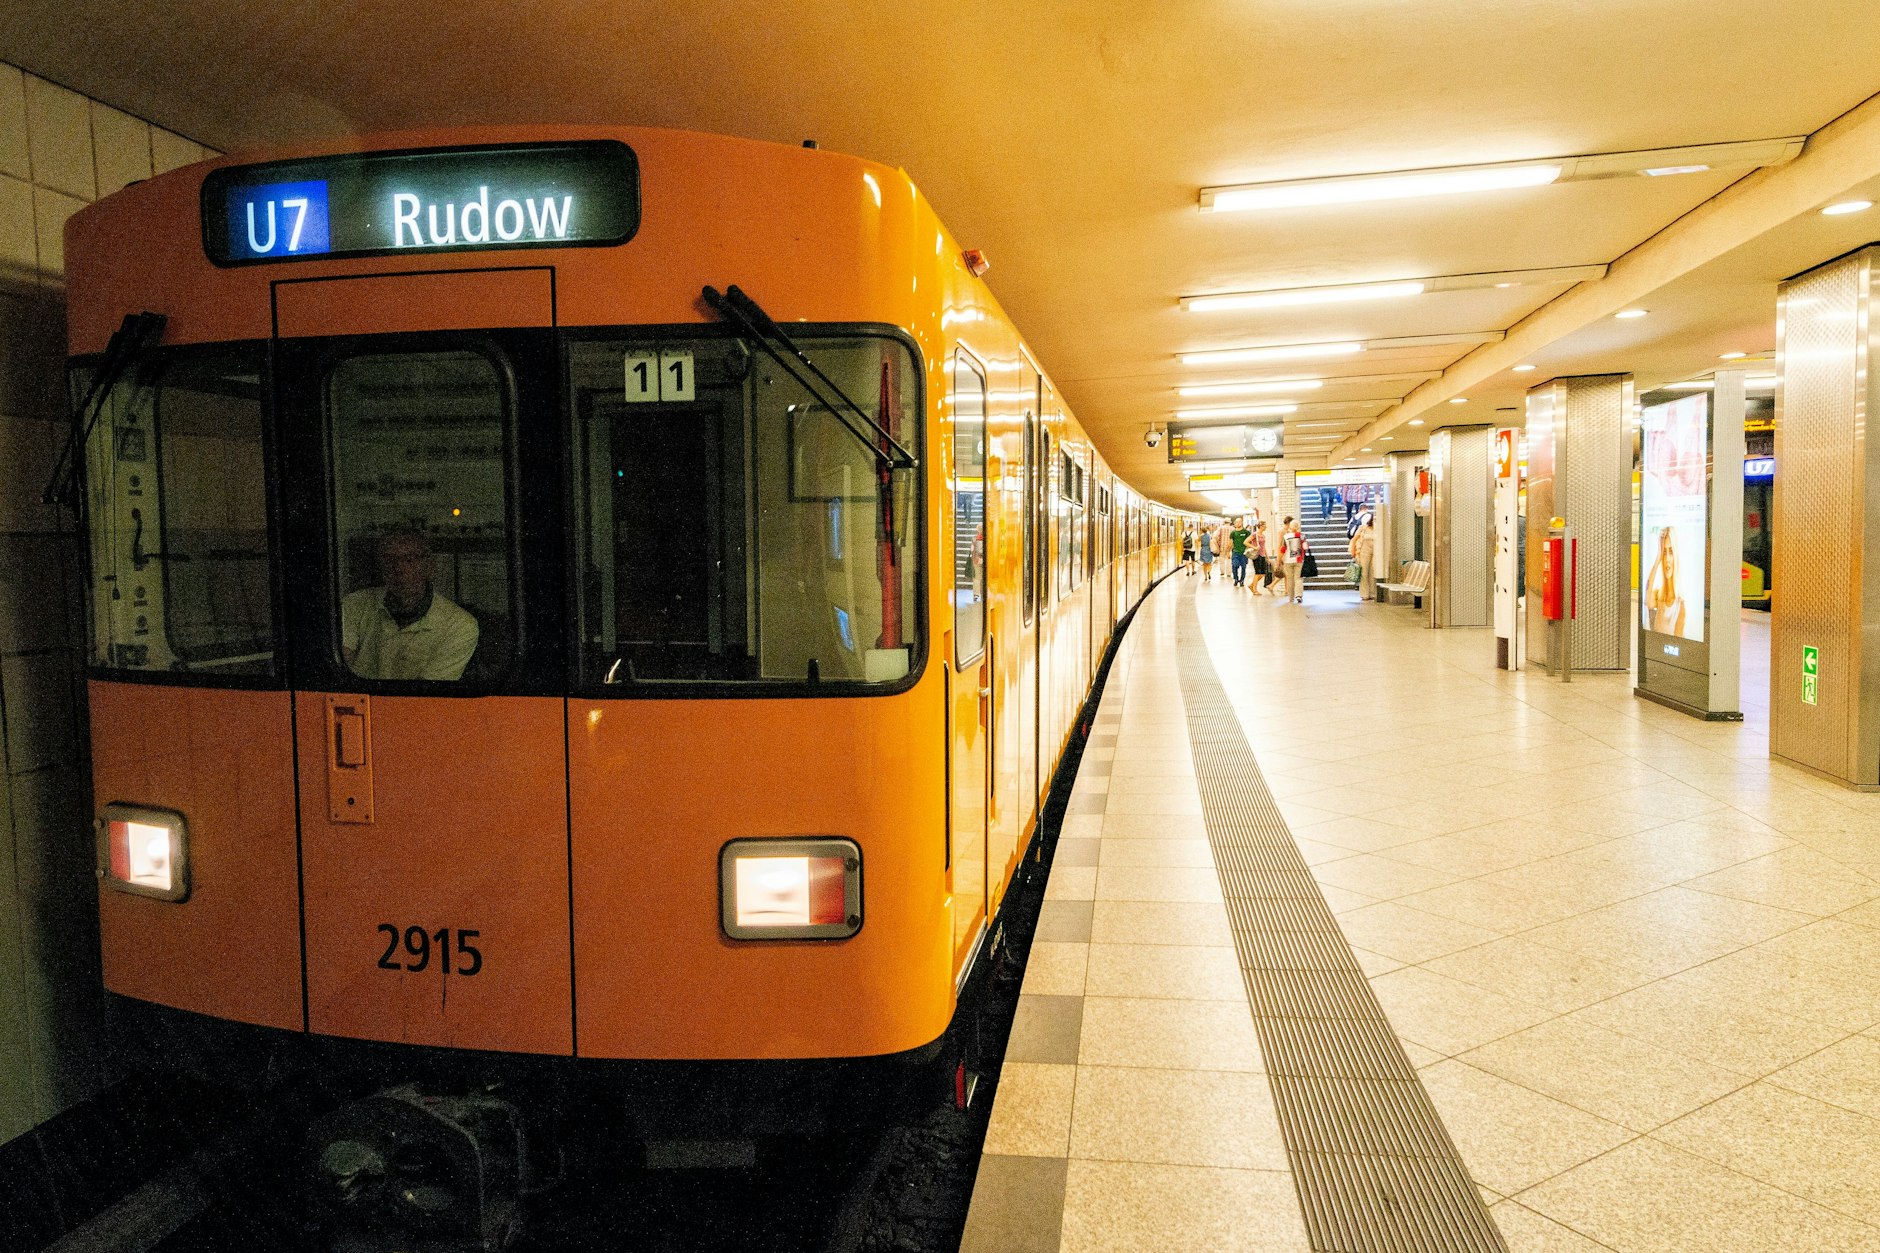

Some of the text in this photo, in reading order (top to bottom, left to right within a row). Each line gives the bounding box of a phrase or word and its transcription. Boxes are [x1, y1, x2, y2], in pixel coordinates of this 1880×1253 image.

[246, 186, 574, 254] U7 Rudow
[1746, 460, 1774, 476] U7
[377, 922, 483, 976] 2915
